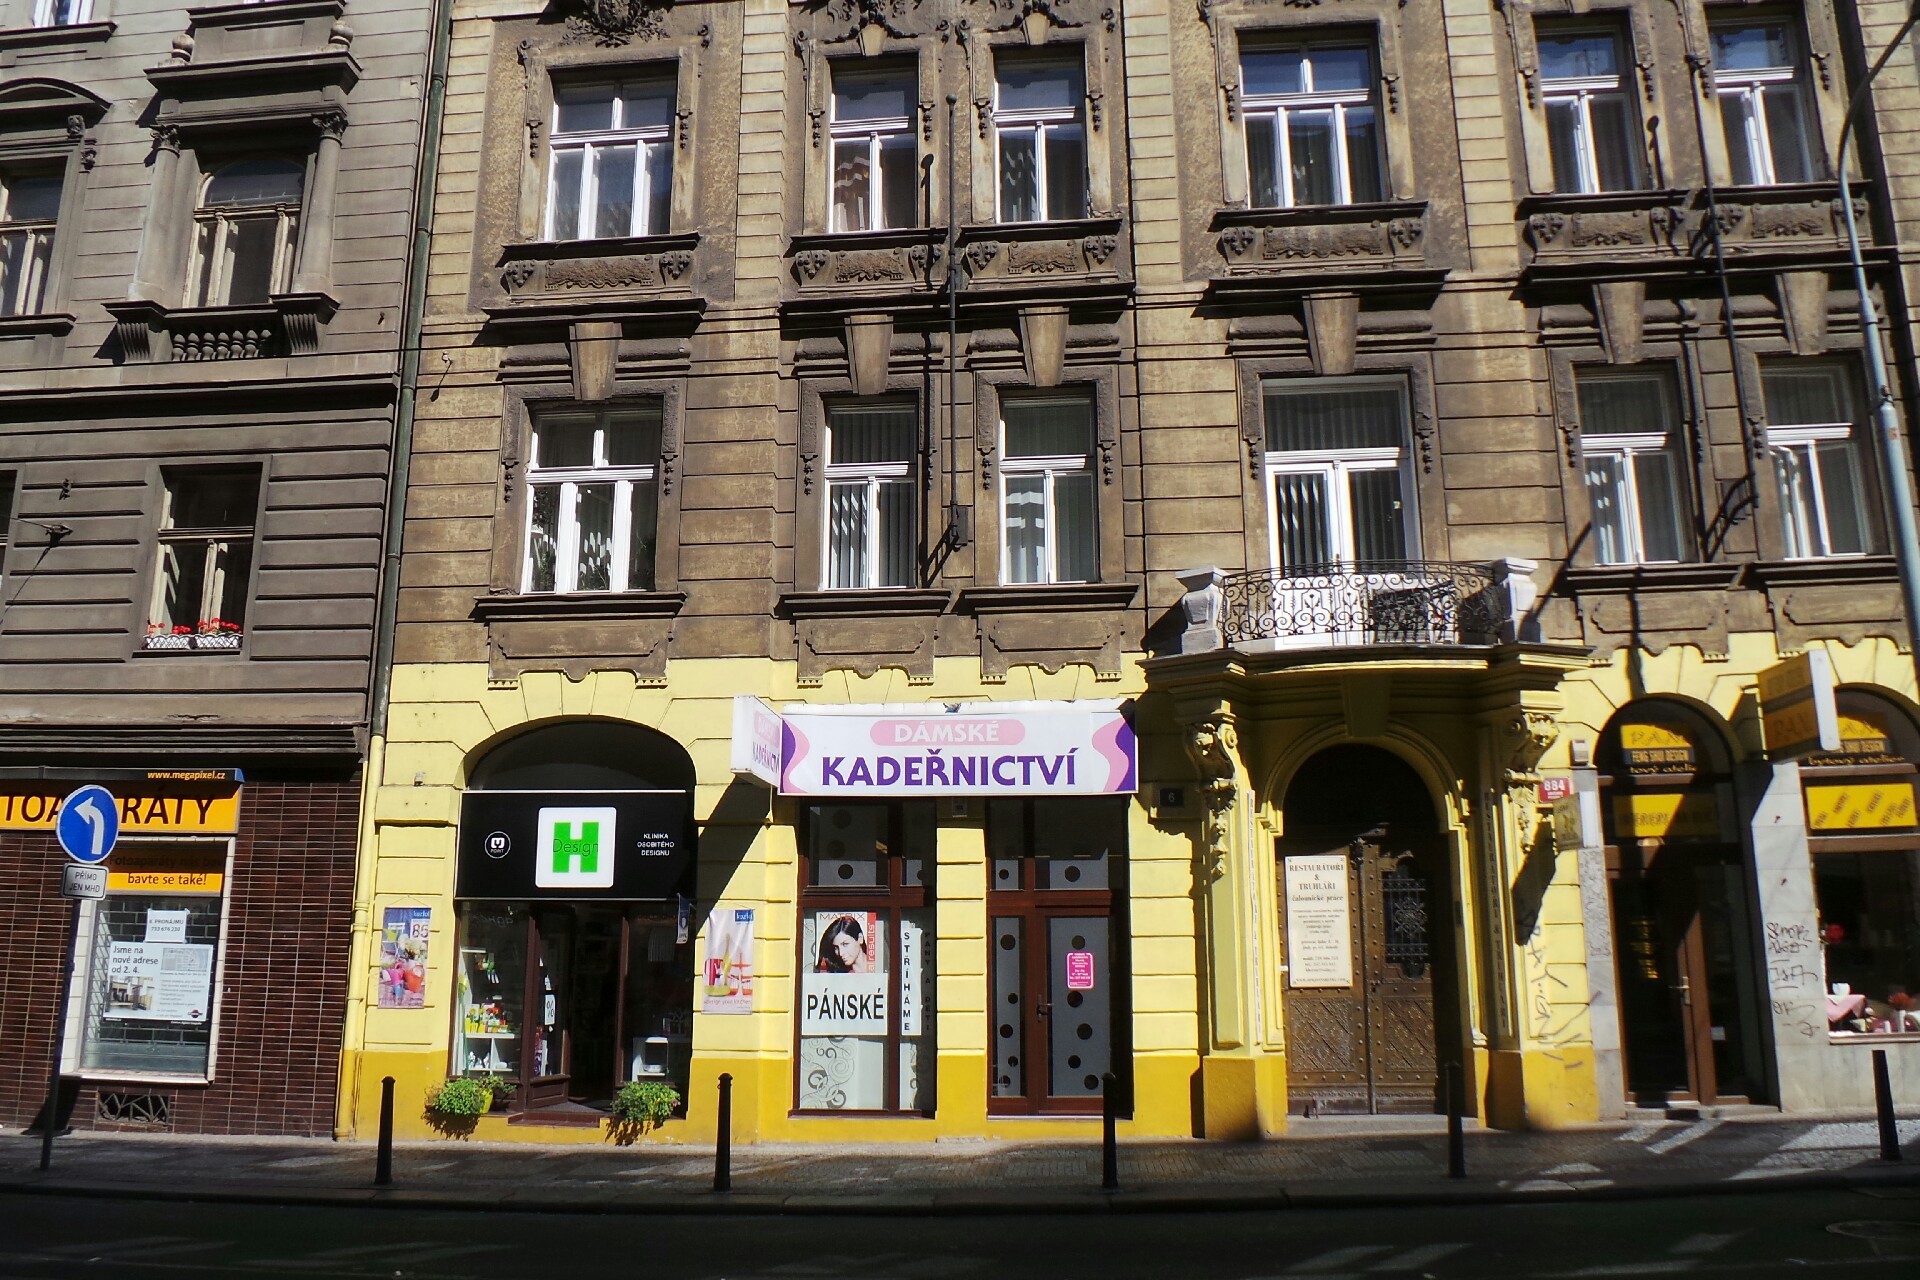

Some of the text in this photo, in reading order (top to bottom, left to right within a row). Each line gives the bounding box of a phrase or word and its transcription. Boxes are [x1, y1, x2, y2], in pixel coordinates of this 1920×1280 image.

[894, 720, 1000, 744] DÁMSKÉ
[821, 747, 1079, 786] KADEŘNICTVÍ
[147, 771, 226, 781] www.megapixel.cz
[1544, 779, 1566, 791] 884
[1168, 792, 1175, 803] 6
[552, 822, 599, 873] H
[552, 838, 599, 857] Design
[641, 849, 670, 857] DESIGNU
[127, 873, 207, 886] bavte se také!
[69, 883, 100, 893] JEN MHD
[113, 946, 132, 954] Jsme
[112, 956, 159, 965] nové adrese
[111, 966, 122, 974] od
[123, 966, 131, 974] 2.
[806, 987, 885, 1020] PÁNSKÉ
